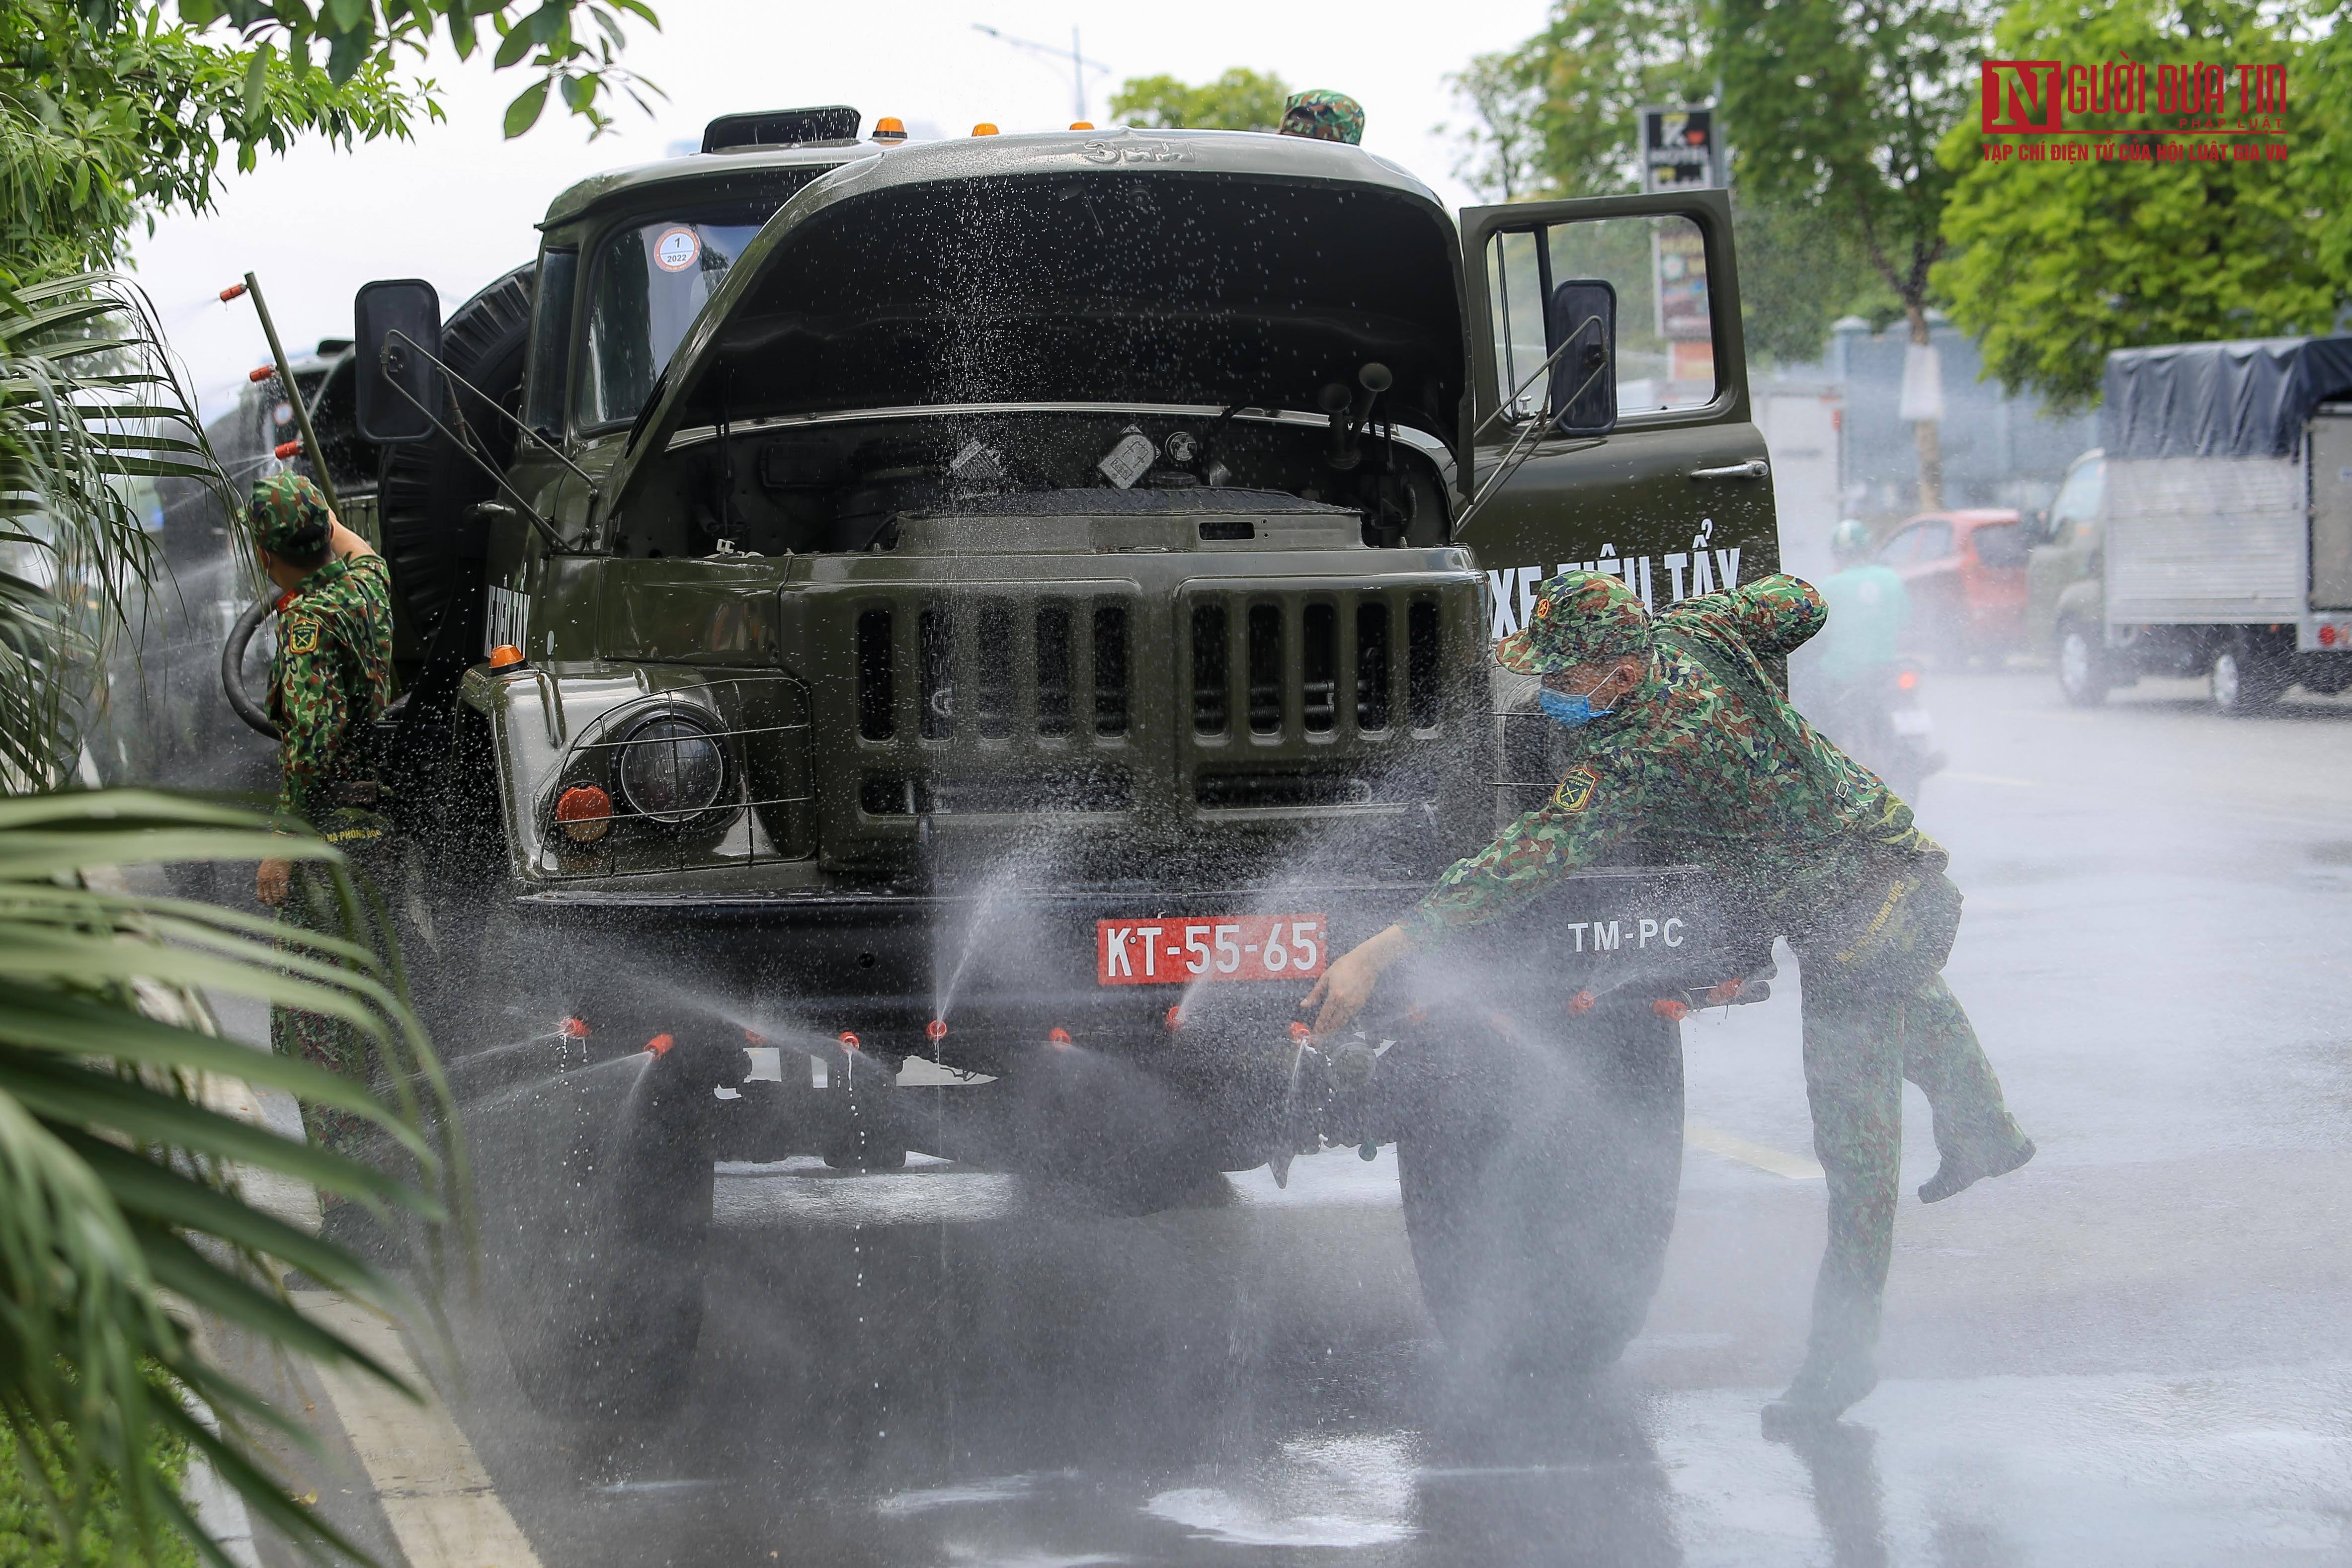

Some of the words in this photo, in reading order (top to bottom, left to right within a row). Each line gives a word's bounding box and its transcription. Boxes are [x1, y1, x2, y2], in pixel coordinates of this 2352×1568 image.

[674, 237, 680, 248] 1
[667, 254, 687, 263] 2022
[1567, 917, 1684, 952] TM-PC
[1107, 922, 1317, 976] KT-55-65
